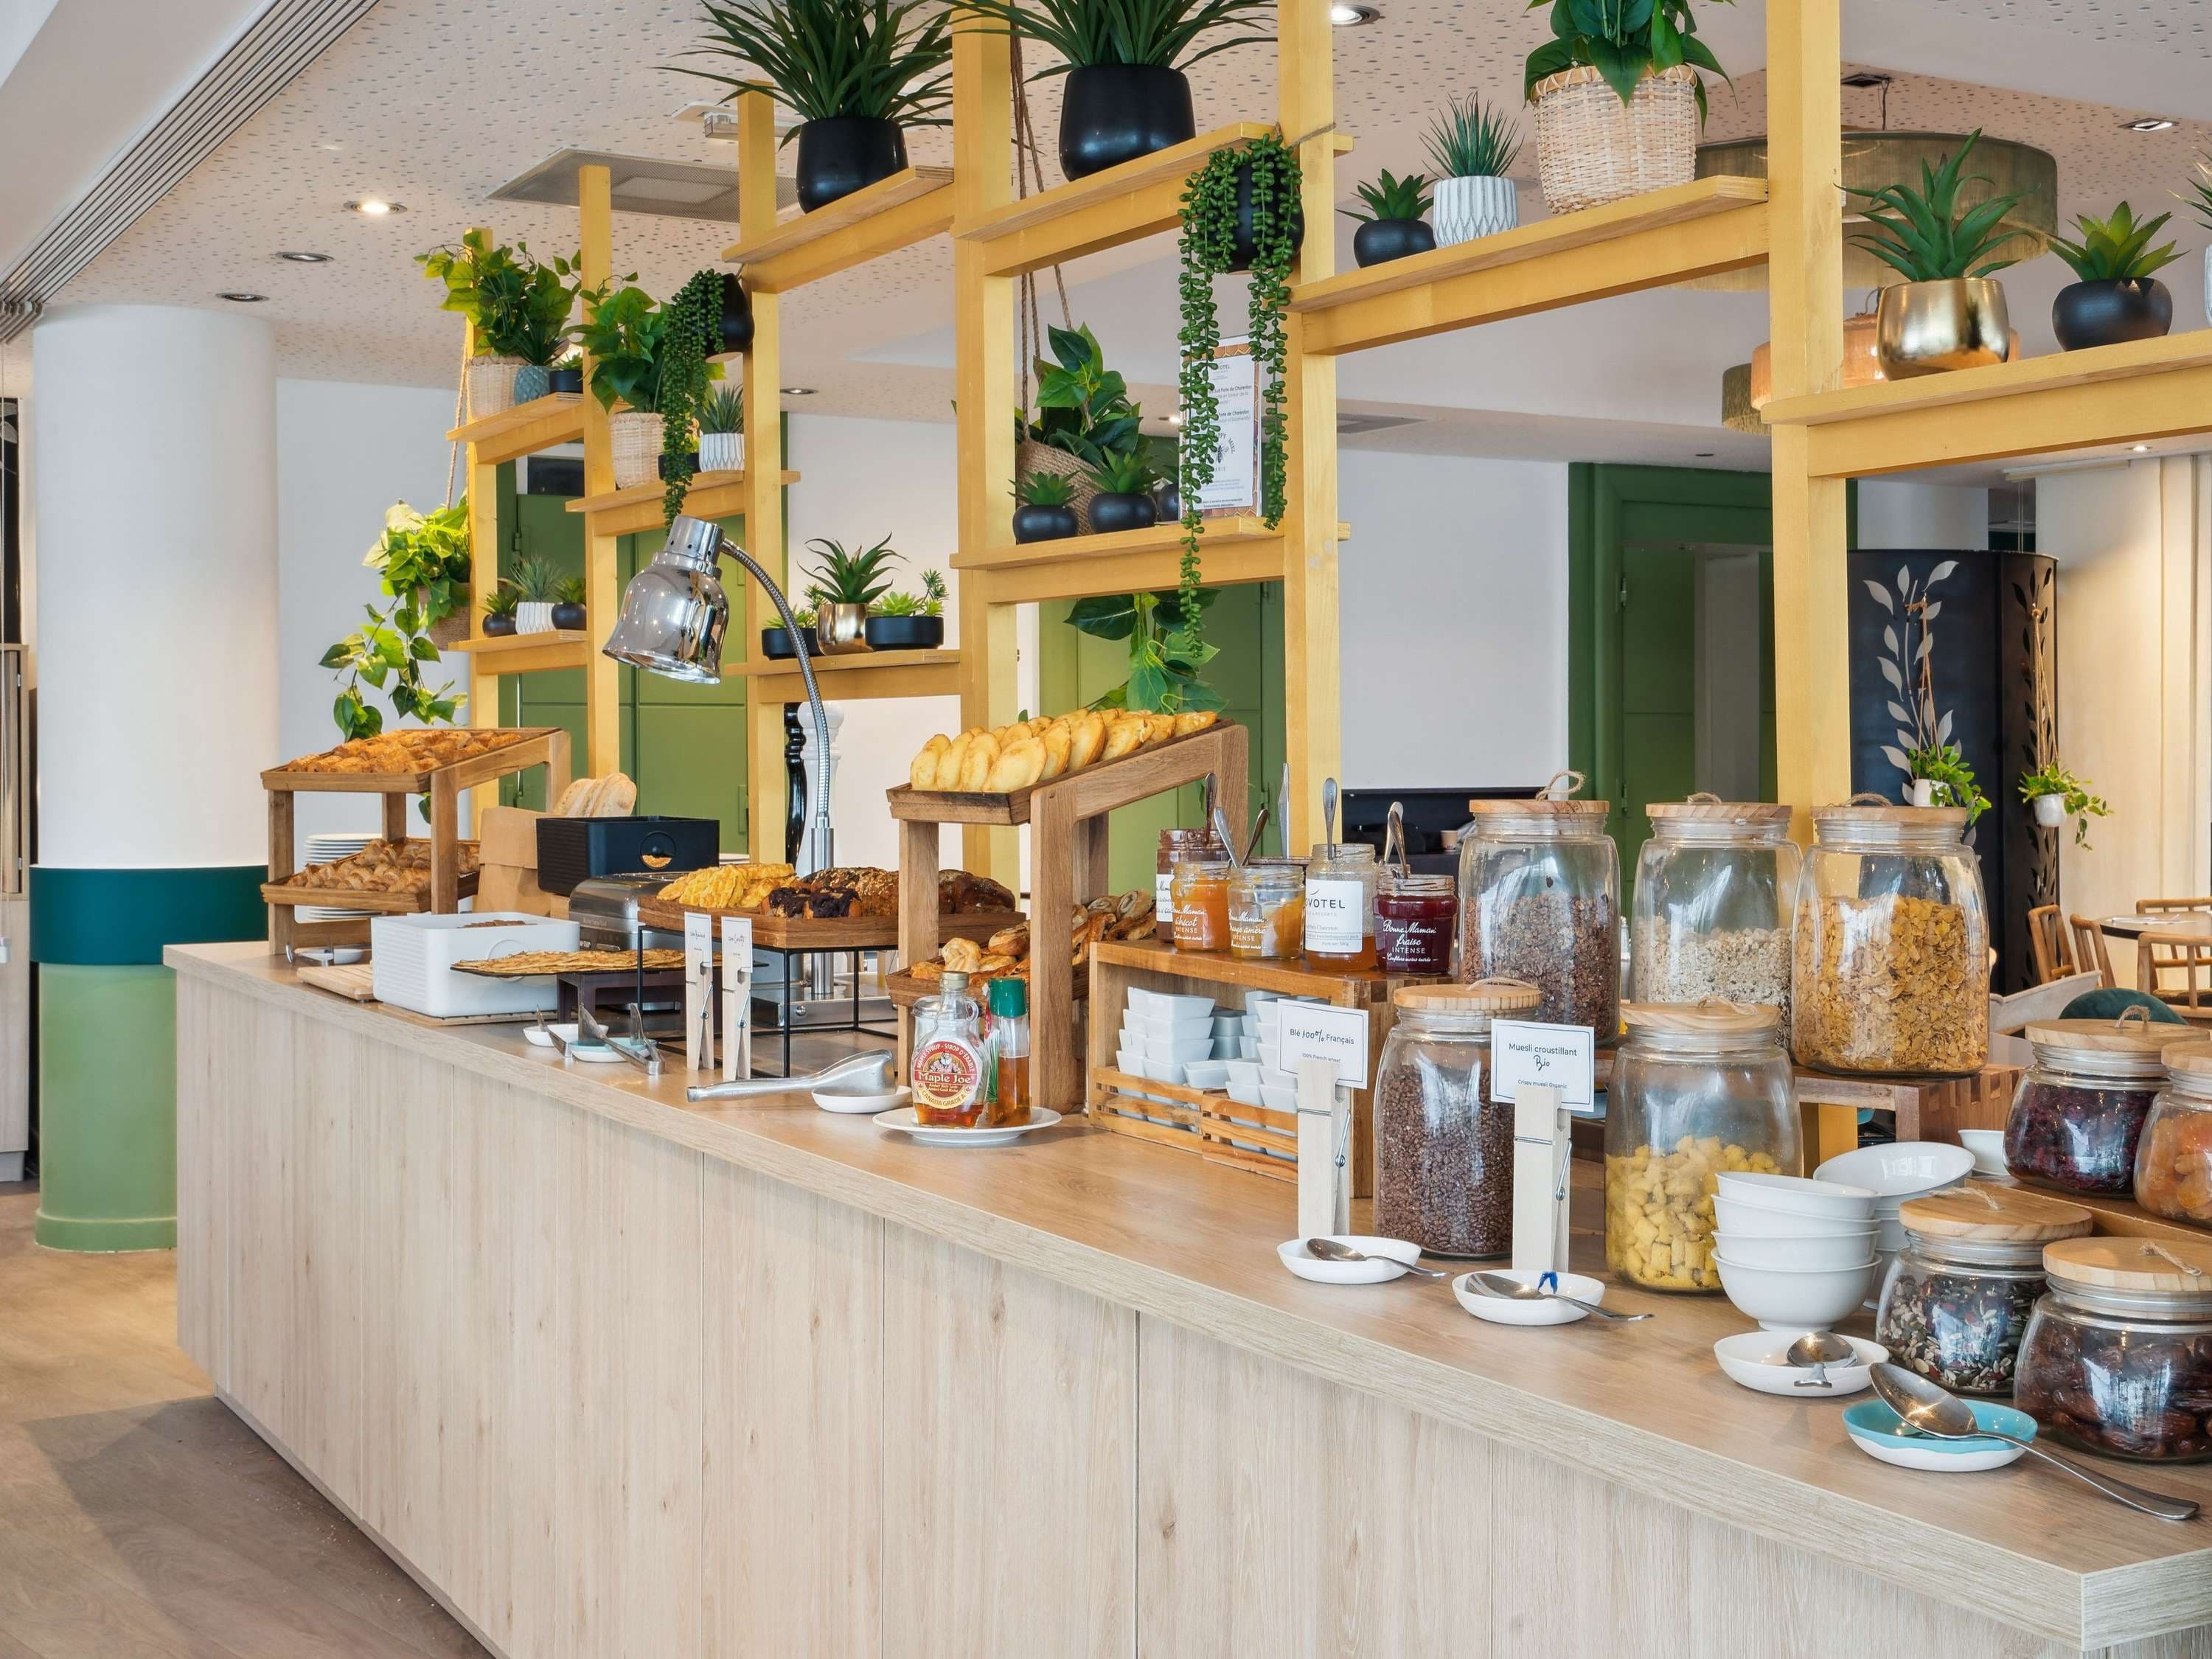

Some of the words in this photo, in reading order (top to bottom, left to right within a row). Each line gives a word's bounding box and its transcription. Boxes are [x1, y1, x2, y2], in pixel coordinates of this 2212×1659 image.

[1383, 919, 1404, 933] Bonne
[1405, 922, 1436, 933] Maman
[1396, 933, 1422, 947] fraise
[1302, 1029, 1324, 1043] 100%
[1326, 1034, 1354, 1045] Français
[917, 1053, 927, 1068] MAPLE
[925, 1043, 941, 1054] SYRUP
[944, 1043, 960, 1051] SIROP
[1509, 1043, 1533, 1052] Muesli
[1534, 1046, 1578, 1056] croustillant
[1534, 1054, 1551, 1071] Bio
[918, 1071, 950, 1083] Maple
[922, 1091, 942, 1106] CANADA
[943, 1097, 960, 1106] GRADE
